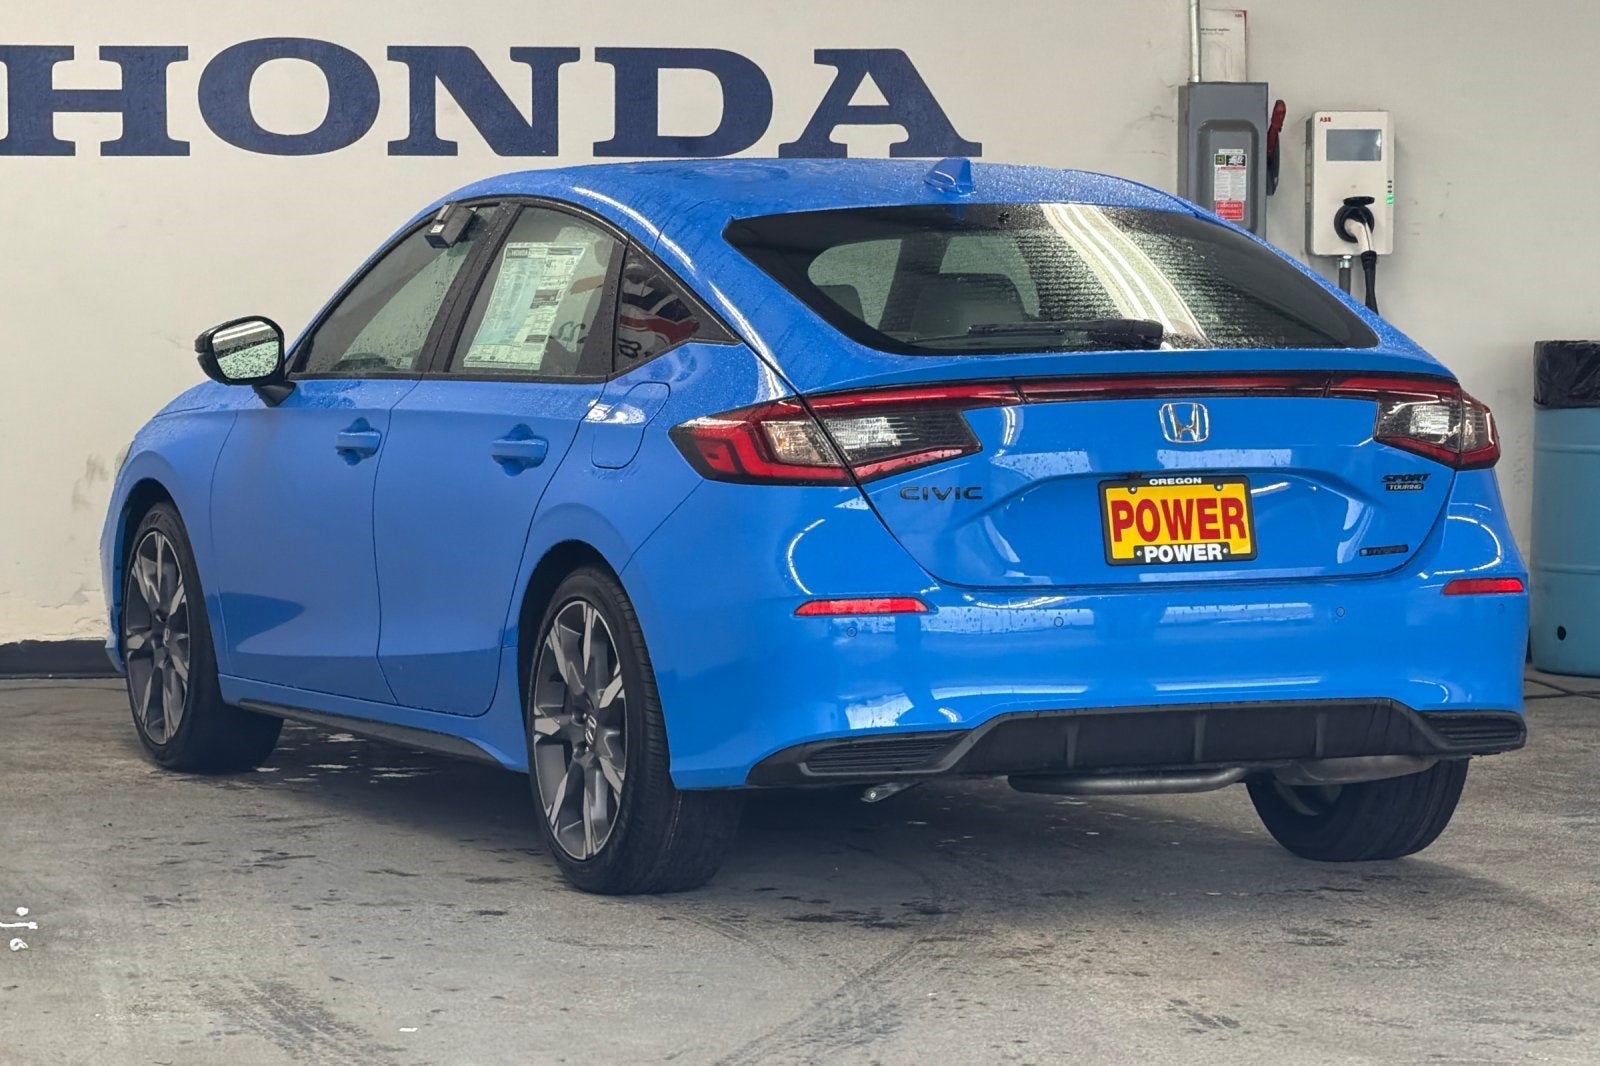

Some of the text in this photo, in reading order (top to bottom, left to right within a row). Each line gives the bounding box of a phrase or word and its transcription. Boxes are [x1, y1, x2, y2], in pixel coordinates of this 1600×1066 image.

[0, 37, 982, 157] HONDA
[1149, 476, 1202, 486] OREGON
[1382, 474, 1431, 483] SPORT
[900, 486, 983, 501] CIVIC
[1110, 497, 1247, 543] POWER
[1144, 543, 1223, 563] POWER
